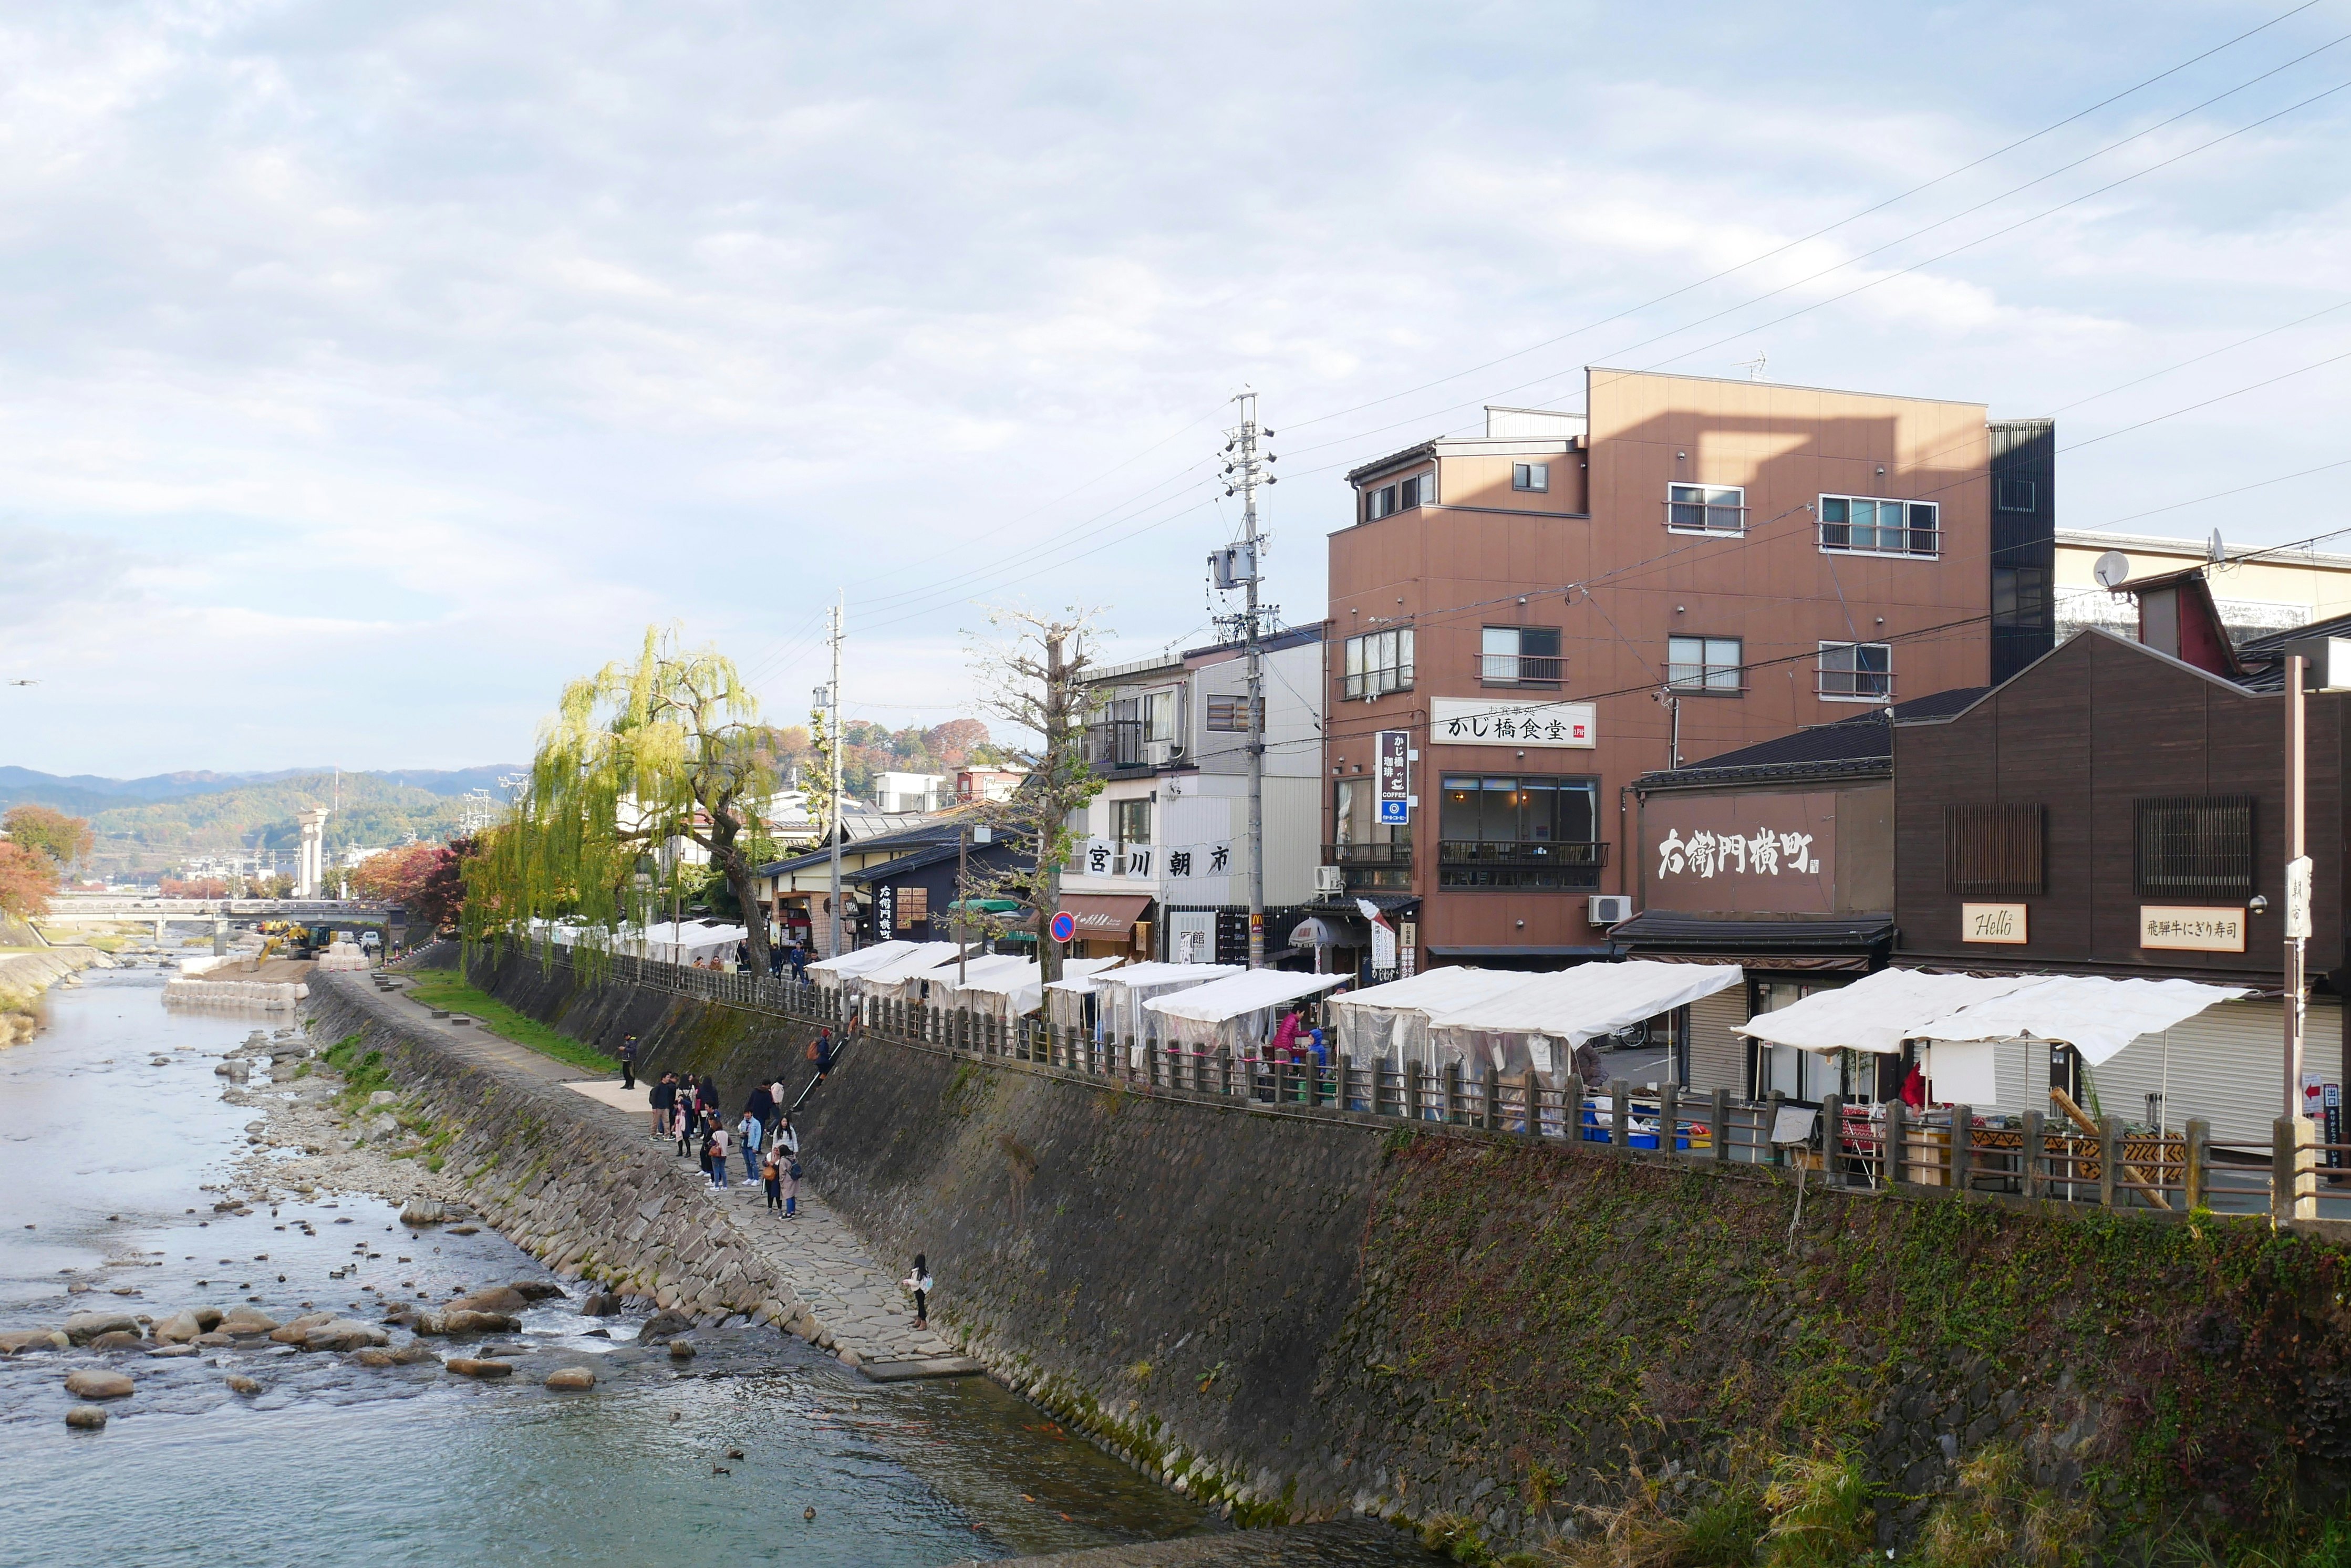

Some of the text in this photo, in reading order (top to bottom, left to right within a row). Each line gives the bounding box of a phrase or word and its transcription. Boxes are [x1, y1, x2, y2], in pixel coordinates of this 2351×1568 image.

[1488, 705, 1535, 716] お食事処
[1448, 716, 1567, 741] かじ橋食堂
[1394, 736, 1404, 767] かじ橋
[1384, 756, 1393, 777] 珈琲
[1089, 845, 1229, 877] 宮川朝市
[1659, 827, 1813, 879] 右衛門横町
[879, 885, 891, 940] 右衛門横町
[2147, 920, 2237, 939] 飛騨牛にぎり寿司
[2328, 1088, 2336, 1105] 出口
